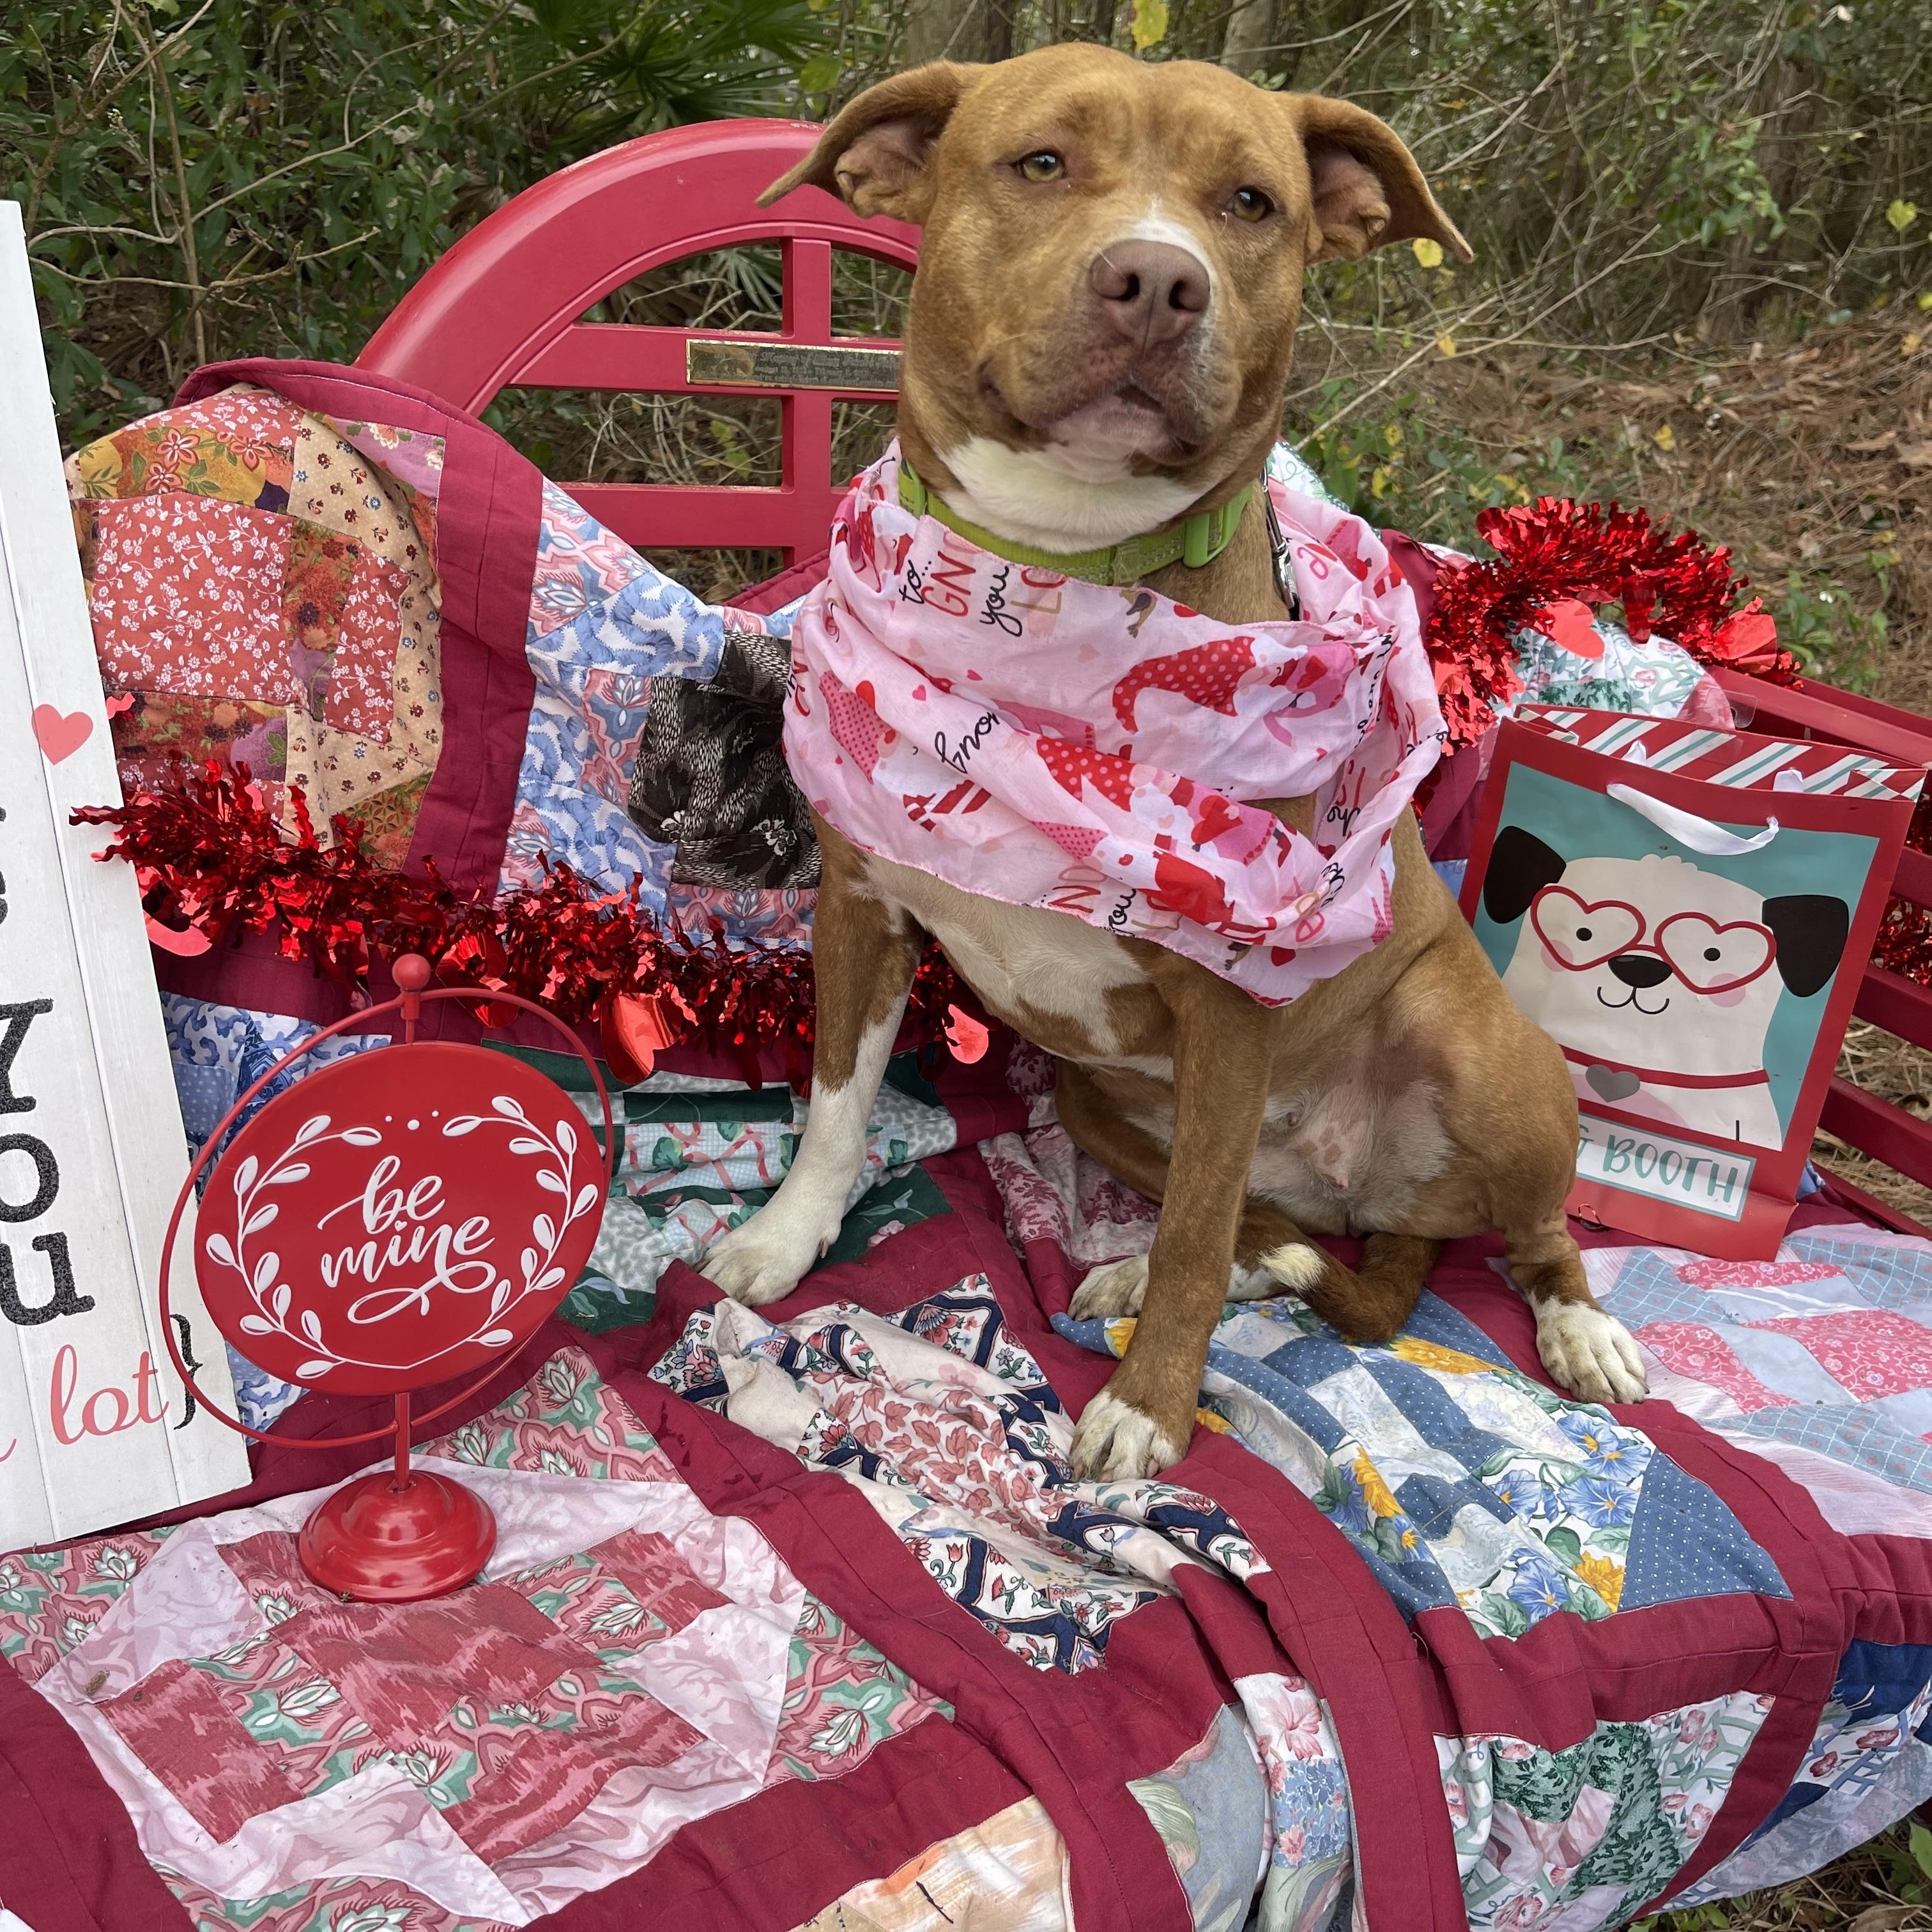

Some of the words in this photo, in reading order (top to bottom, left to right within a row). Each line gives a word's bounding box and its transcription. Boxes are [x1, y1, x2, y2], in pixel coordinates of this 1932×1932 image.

[979, 565, 1023, 638] you
[318, 1154, 446, 1234] be
[1602, 1134, 1738, 1203] BOOTH
[321, 1216, 497, 1324] mine
